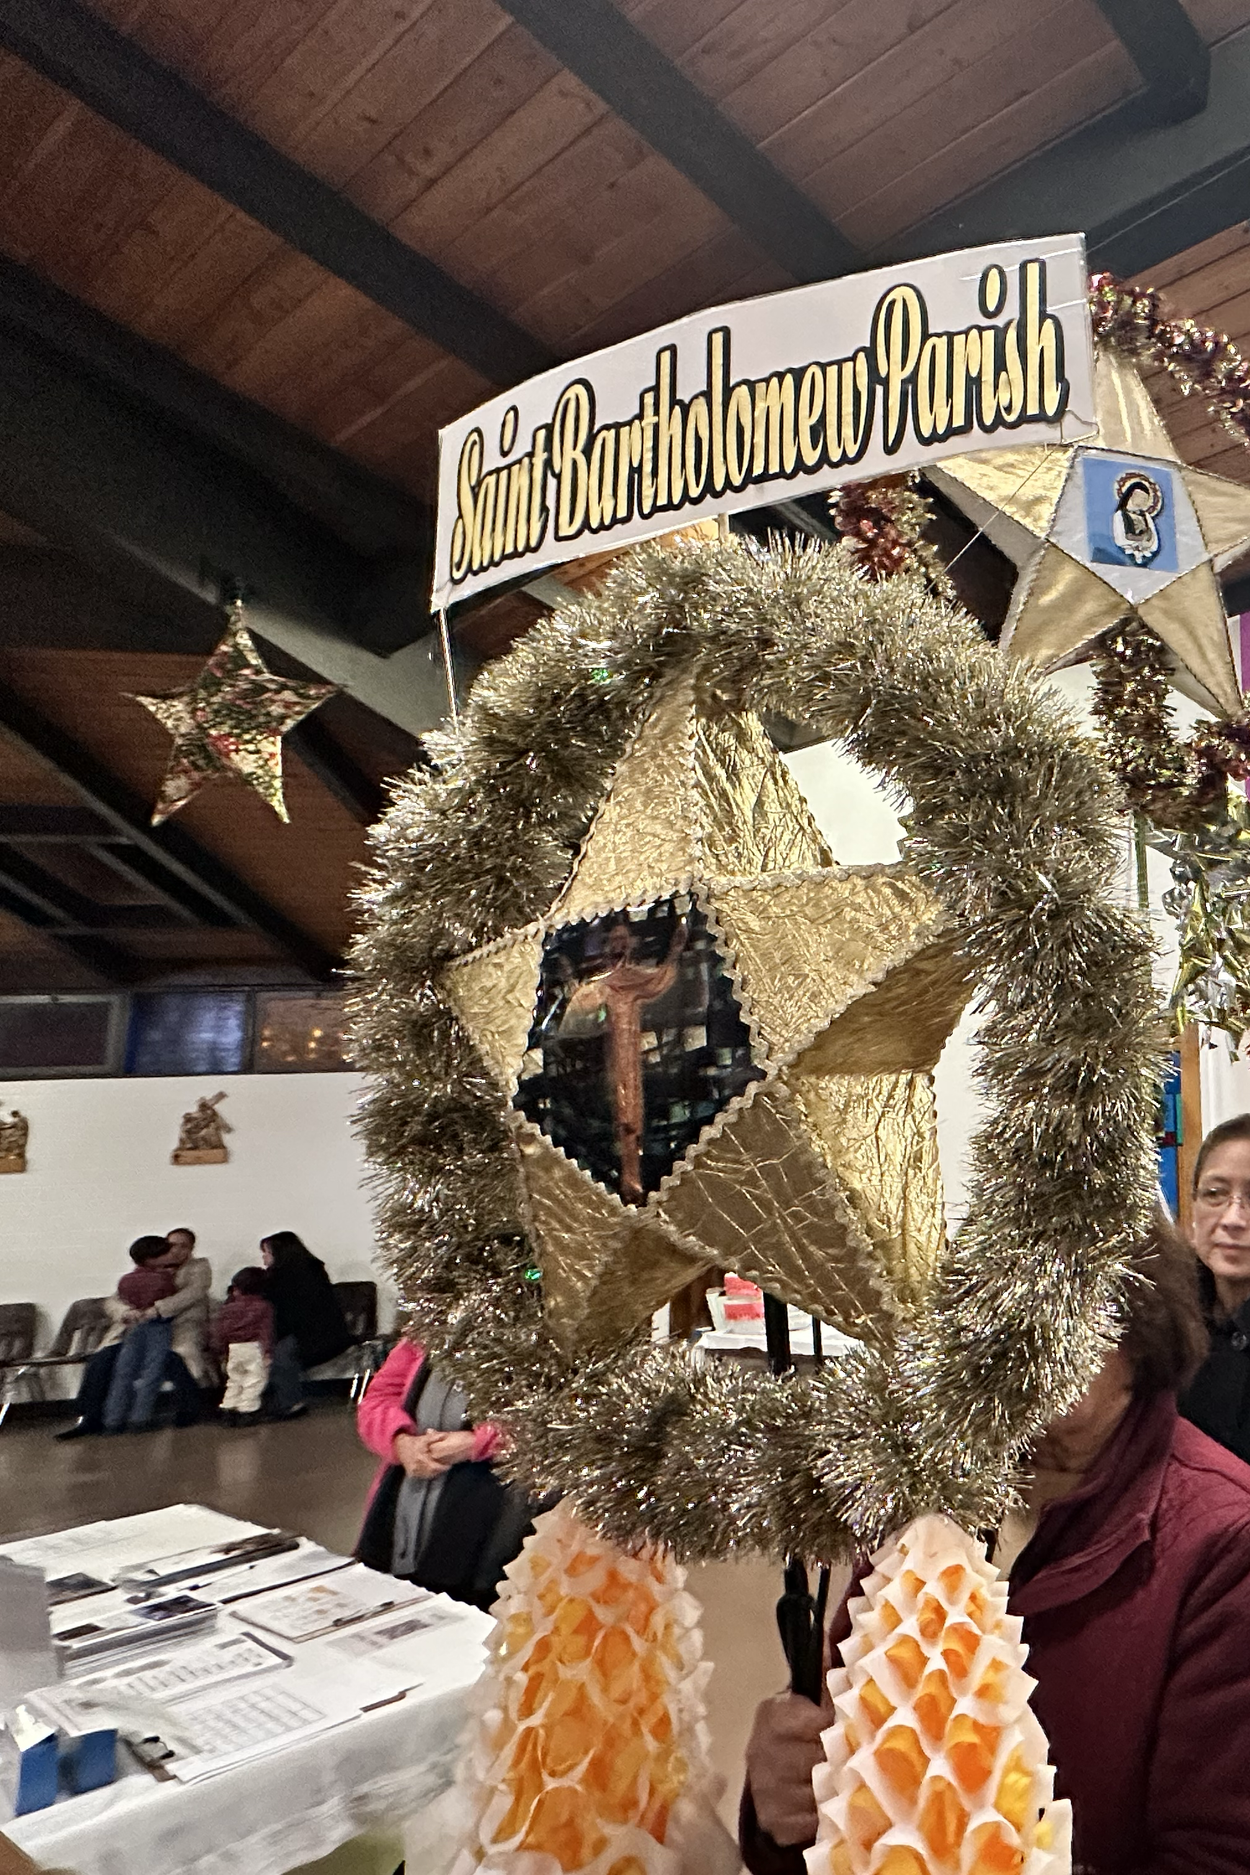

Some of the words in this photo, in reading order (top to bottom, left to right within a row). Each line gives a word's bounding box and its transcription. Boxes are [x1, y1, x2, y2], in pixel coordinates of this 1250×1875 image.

[450, 404, 551, 584] Saint
[549, 326, 873, 541] Bartholomew
[869, 258, 1071, 455] Parish
